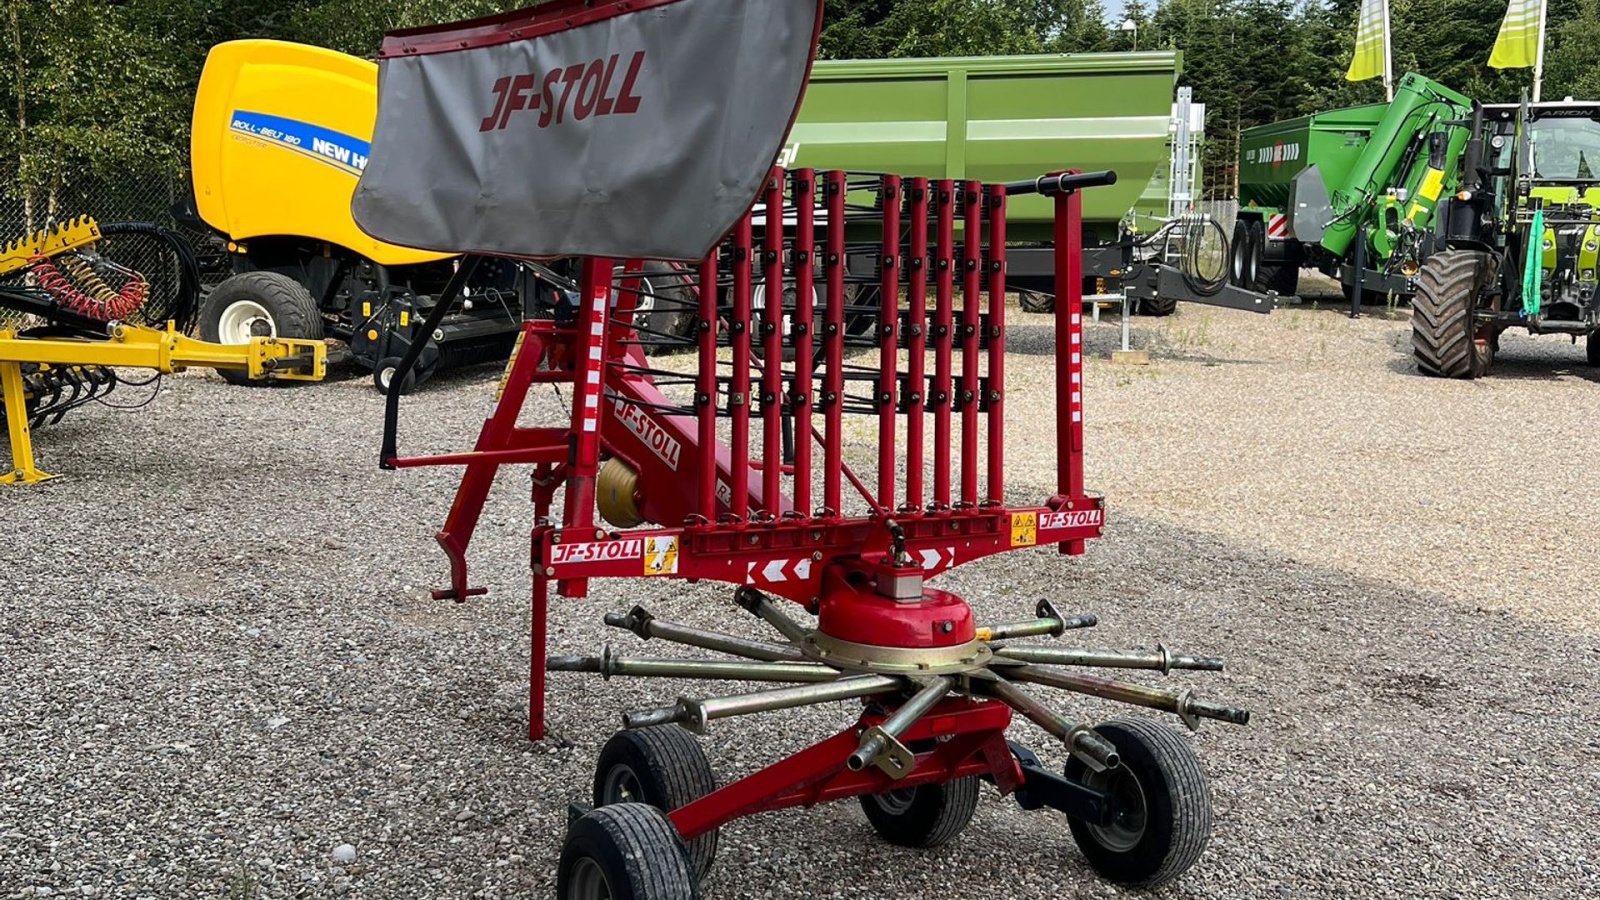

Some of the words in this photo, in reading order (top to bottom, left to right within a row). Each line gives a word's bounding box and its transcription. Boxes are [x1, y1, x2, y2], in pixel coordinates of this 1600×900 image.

[479, 51, 645, 132] JF-STOLL
[232, 119, 283, 139] ROLL-BELT
[312, 137, 350, 163] NEW
[615, 397, 679, 467] JF-STOLL
[1040, 510, 1100, 528] JF-STOLL
[553, 540, 640, 562] JF-STOLL
